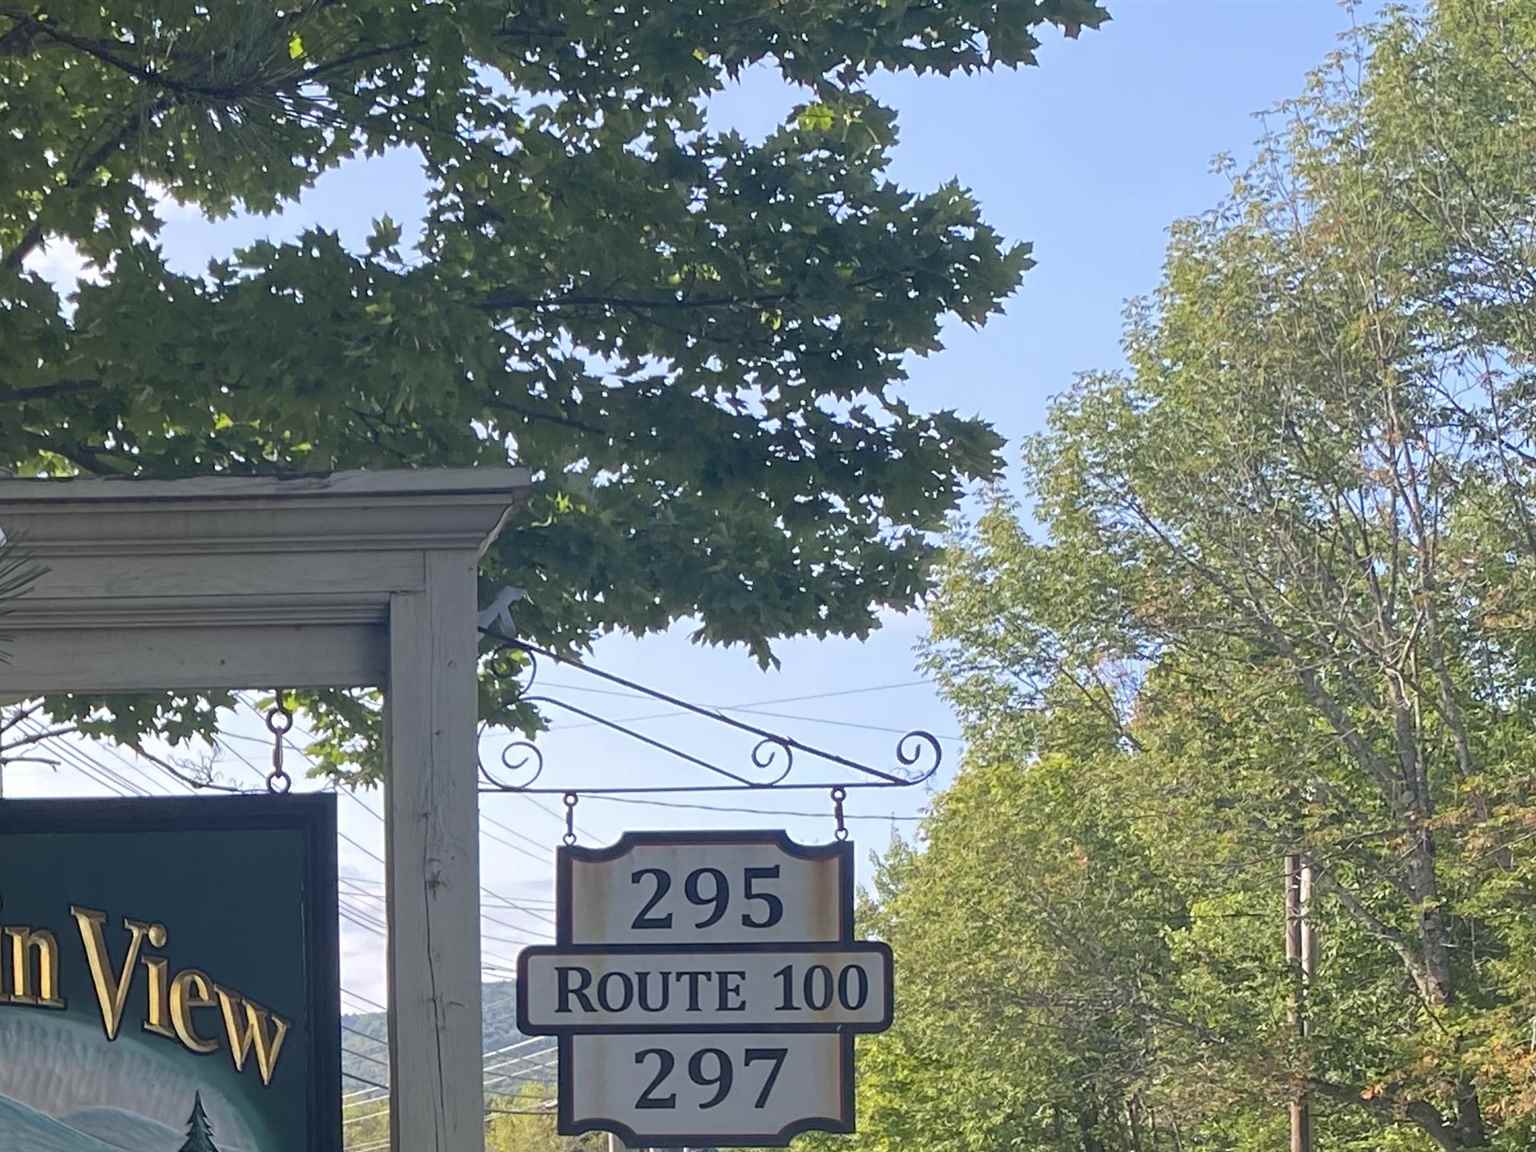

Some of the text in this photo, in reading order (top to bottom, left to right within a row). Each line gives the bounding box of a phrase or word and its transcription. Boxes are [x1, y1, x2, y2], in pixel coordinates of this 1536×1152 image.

[630, 864, 784, 930] 295
[70, 903, 290, 1085] View
[554, 963, 869, 1013] ROUTE 100
[634, 1047, 789, 1109] 297
